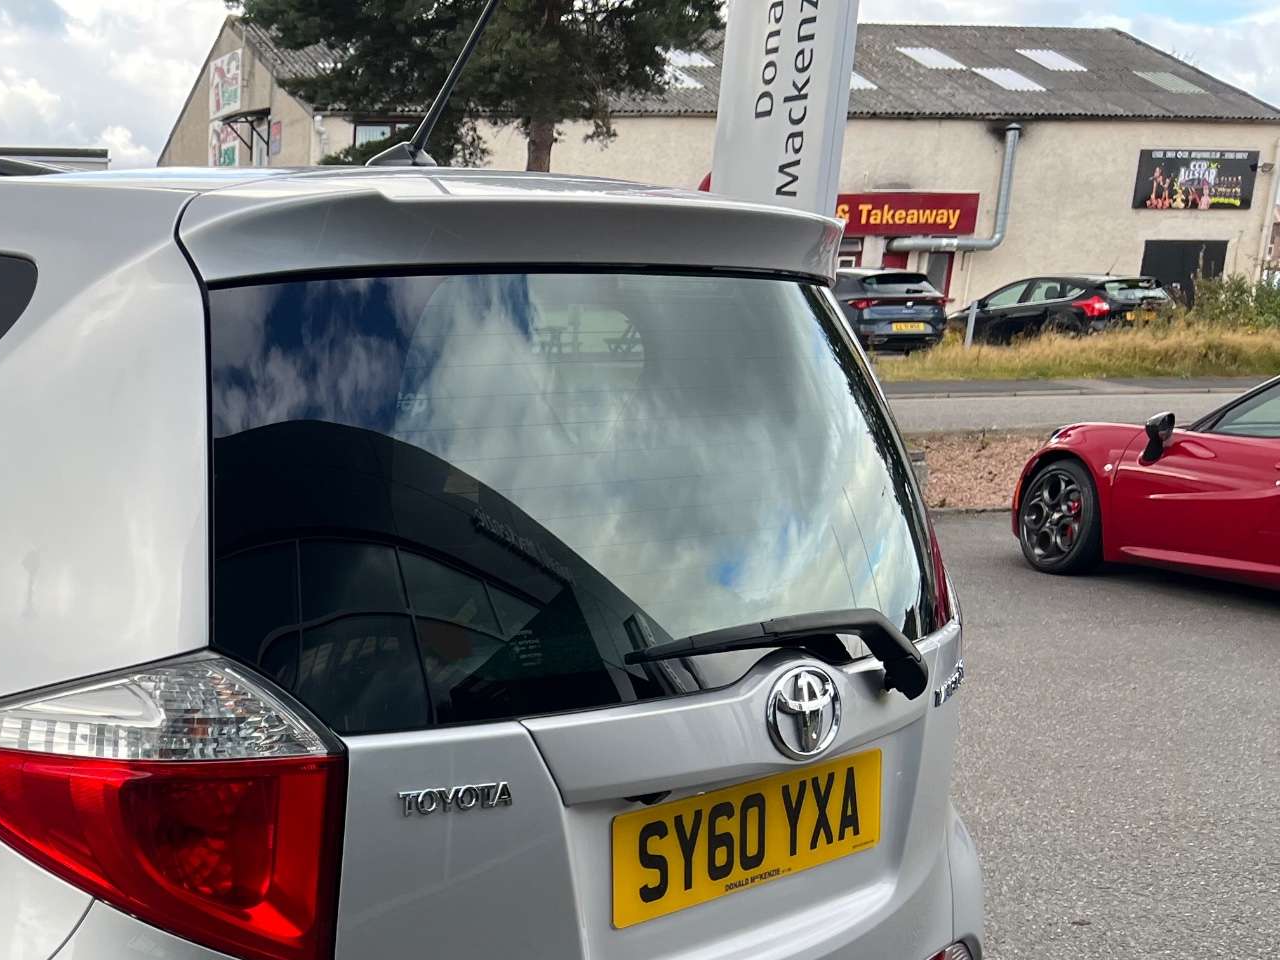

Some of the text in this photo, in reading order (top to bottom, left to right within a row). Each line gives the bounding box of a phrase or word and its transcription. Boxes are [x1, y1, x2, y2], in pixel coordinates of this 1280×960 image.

[858, 203, 961, 230] Takeaway
[397, 781, 513, 817] TOYOTA
[638, 766, 861, 904] SY60 YXA
[724, 877, 750, 892] DONALD
